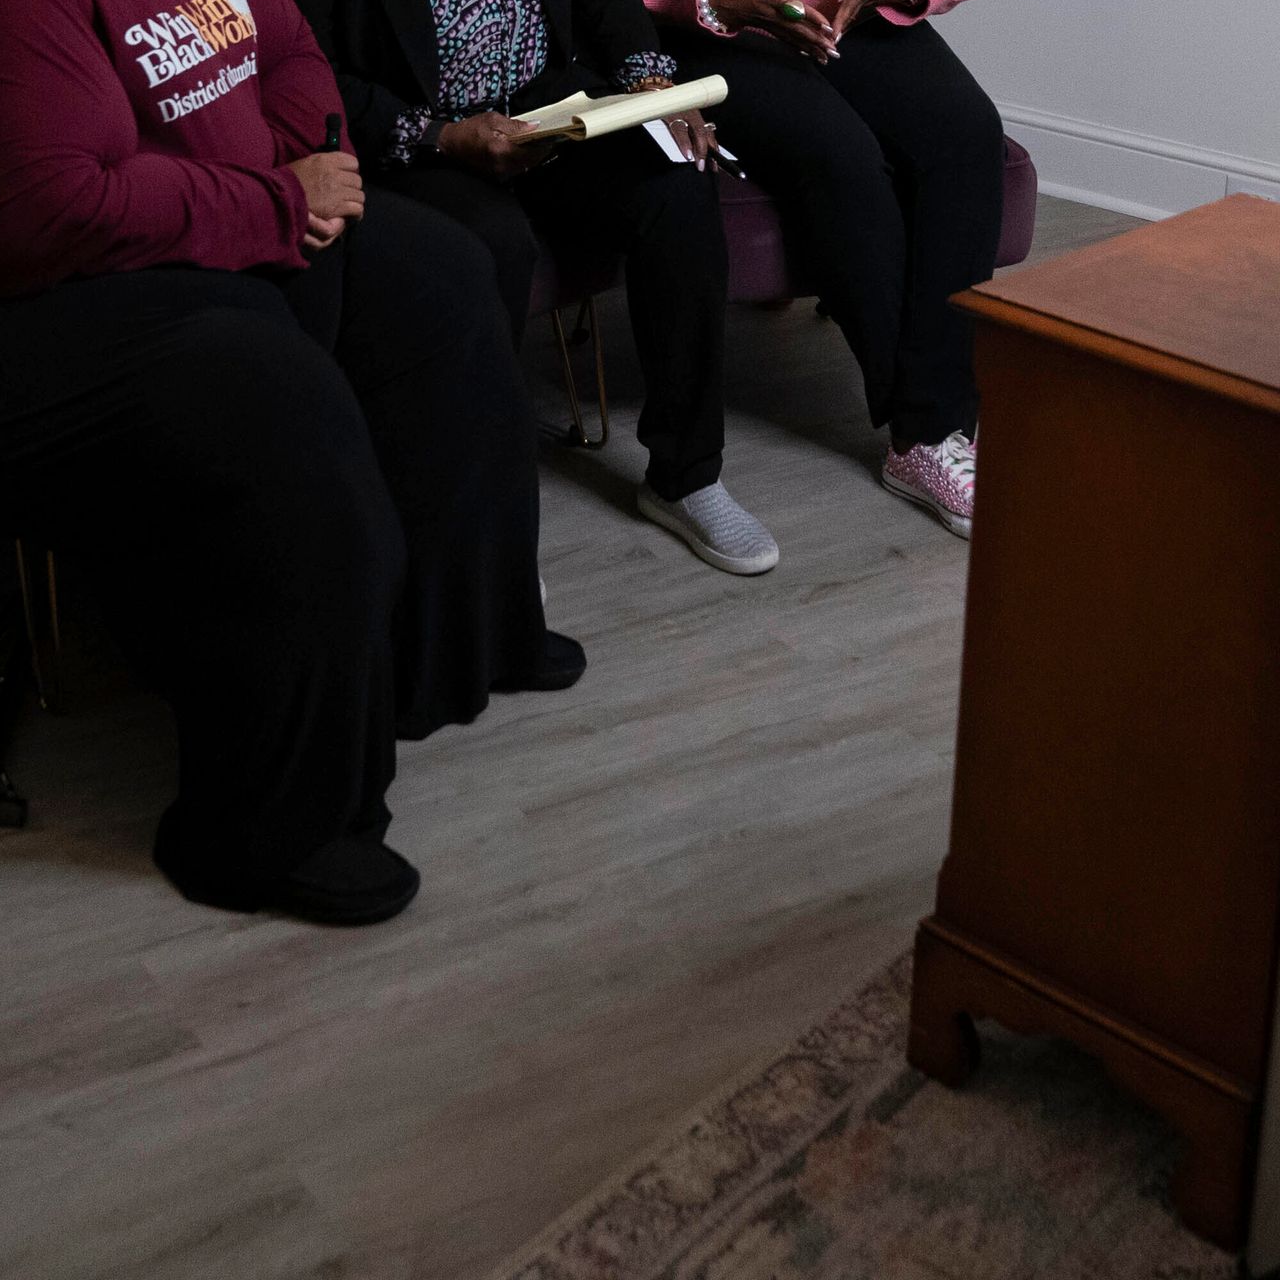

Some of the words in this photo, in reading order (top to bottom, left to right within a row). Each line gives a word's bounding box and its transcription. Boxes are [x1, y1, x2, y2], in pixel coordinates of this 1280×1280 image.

[124, 11, 196, 49] Win
[157, 79, 220, 123] District
[217, 68, 230, 95] of
